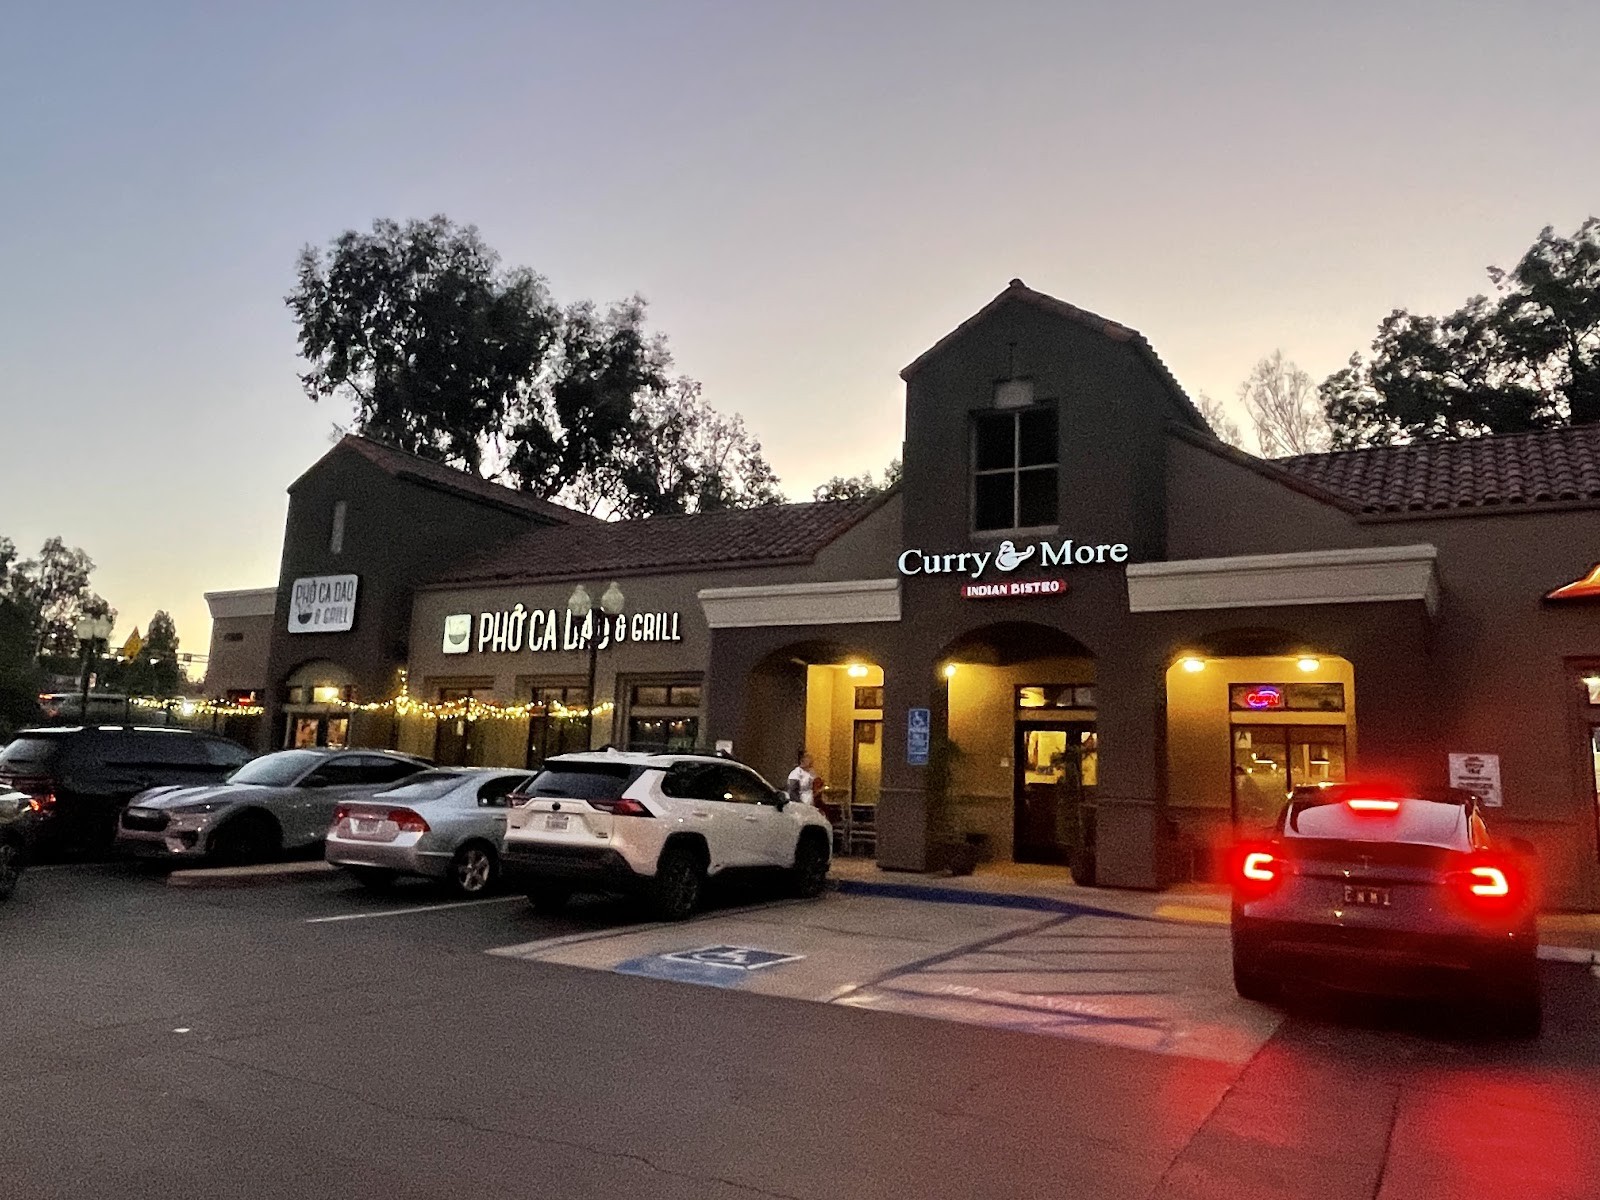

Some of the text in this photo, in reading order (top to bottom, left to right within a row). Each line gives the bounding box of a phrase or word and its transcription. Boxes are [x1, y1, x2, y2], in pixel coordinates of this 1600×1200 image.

[898, 548, 992, 578] Curry
[1039, 539, 1129, 567] More
[319, 582, 332, 604] CA
[334, 580, 354, 602] DAO
[966, 580, 1060, 597] INDIAN BISTRO
[323, 607, 348, 625] GRILL
[528, 608, 557, 652] CA
[615, 613, 627, 643] &
[631, 611, 681, 642] GRILL
